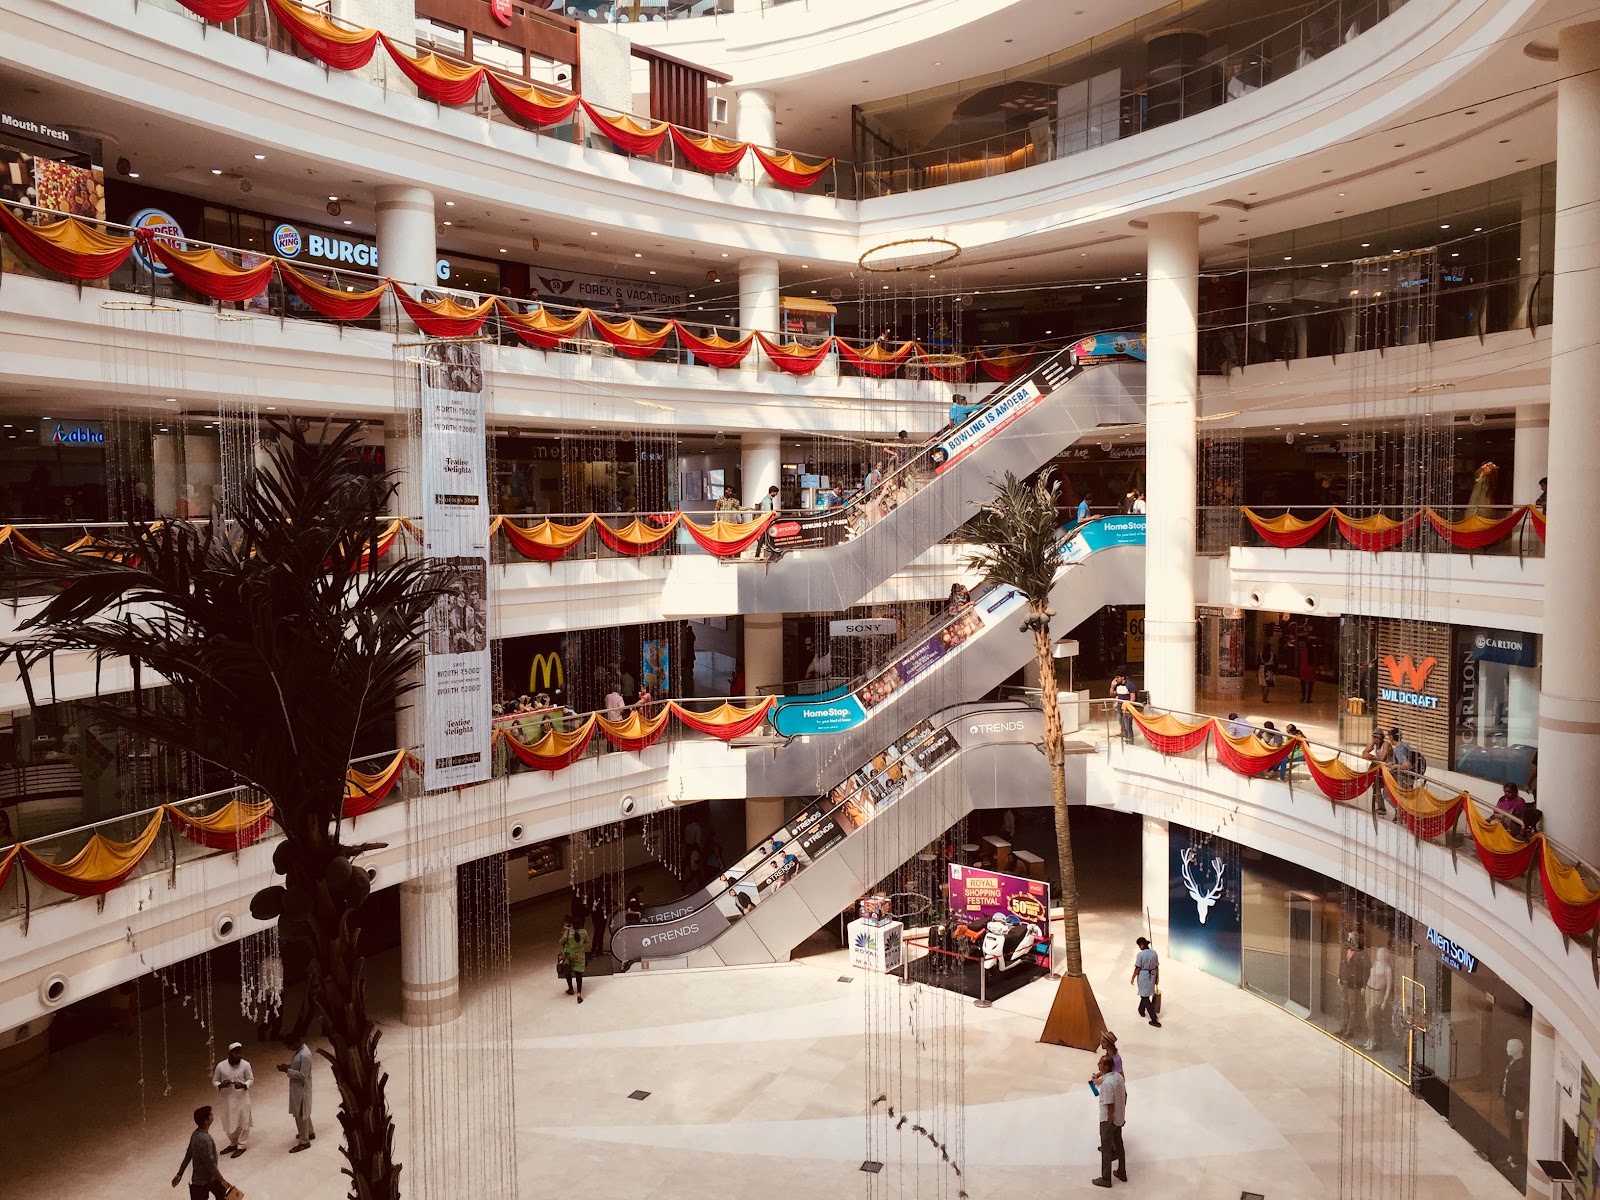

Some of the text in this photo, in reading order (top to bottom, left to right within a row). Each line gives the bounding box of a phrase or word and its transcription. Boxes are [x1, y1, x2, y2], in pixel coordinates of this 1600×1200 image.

[2, 114, 70, 141] Mouth Fresh
[278, 233, 298, 242] BURGER
[279, 239, 299, 248] KING
[309, 234, 378, 267] BURGE
[579, 283, 612, 296] FOREX
[616, 288, 623, 298] &
[626, 289, 681, 305] VACATIONS
[948, 420, 986, 450] BOWLING
[985, 412, 996, 424] IS
[995, 388, 1029, 417] AMOEBA
[778, 525, 799, 533] amoeba
[1104, 522, 1146, 532] HomeStop
[846, 624, 881, 633] SONY
[1486, 638, 1523, 651] CARLTON
[1381, 689, 1438, 709] WILDCRAFT
[1462, 650, 1476, 744] CARLTON
[803, 707, 848, 718] HomeStop
[978, 721, 1024, 734] TRENDS
[907, 728, 931, 748] TRENDS
[923, 735, 949, 757] TRENDS
[796, 811, 821, 831] TRENDS
[808, 822, 834, 844] TRENDS
[770, 861, 796, 881] TRENDS
[970, 880, 995, 888] ROYAL
[965, 889, 1001, 897] SHOPPING
[967, 897, 1000, 905] FESTIVAL
[649, 906, 694, 923] TRENDS
[1012, 899, 1026, 914] 50
[650, 924, 699, 944] TRENDS
[855, 948, 878, 957] ROYAL
[1426, 927, 1474, 974] Allen Solly
[856, 958, 878, 968] MALL
